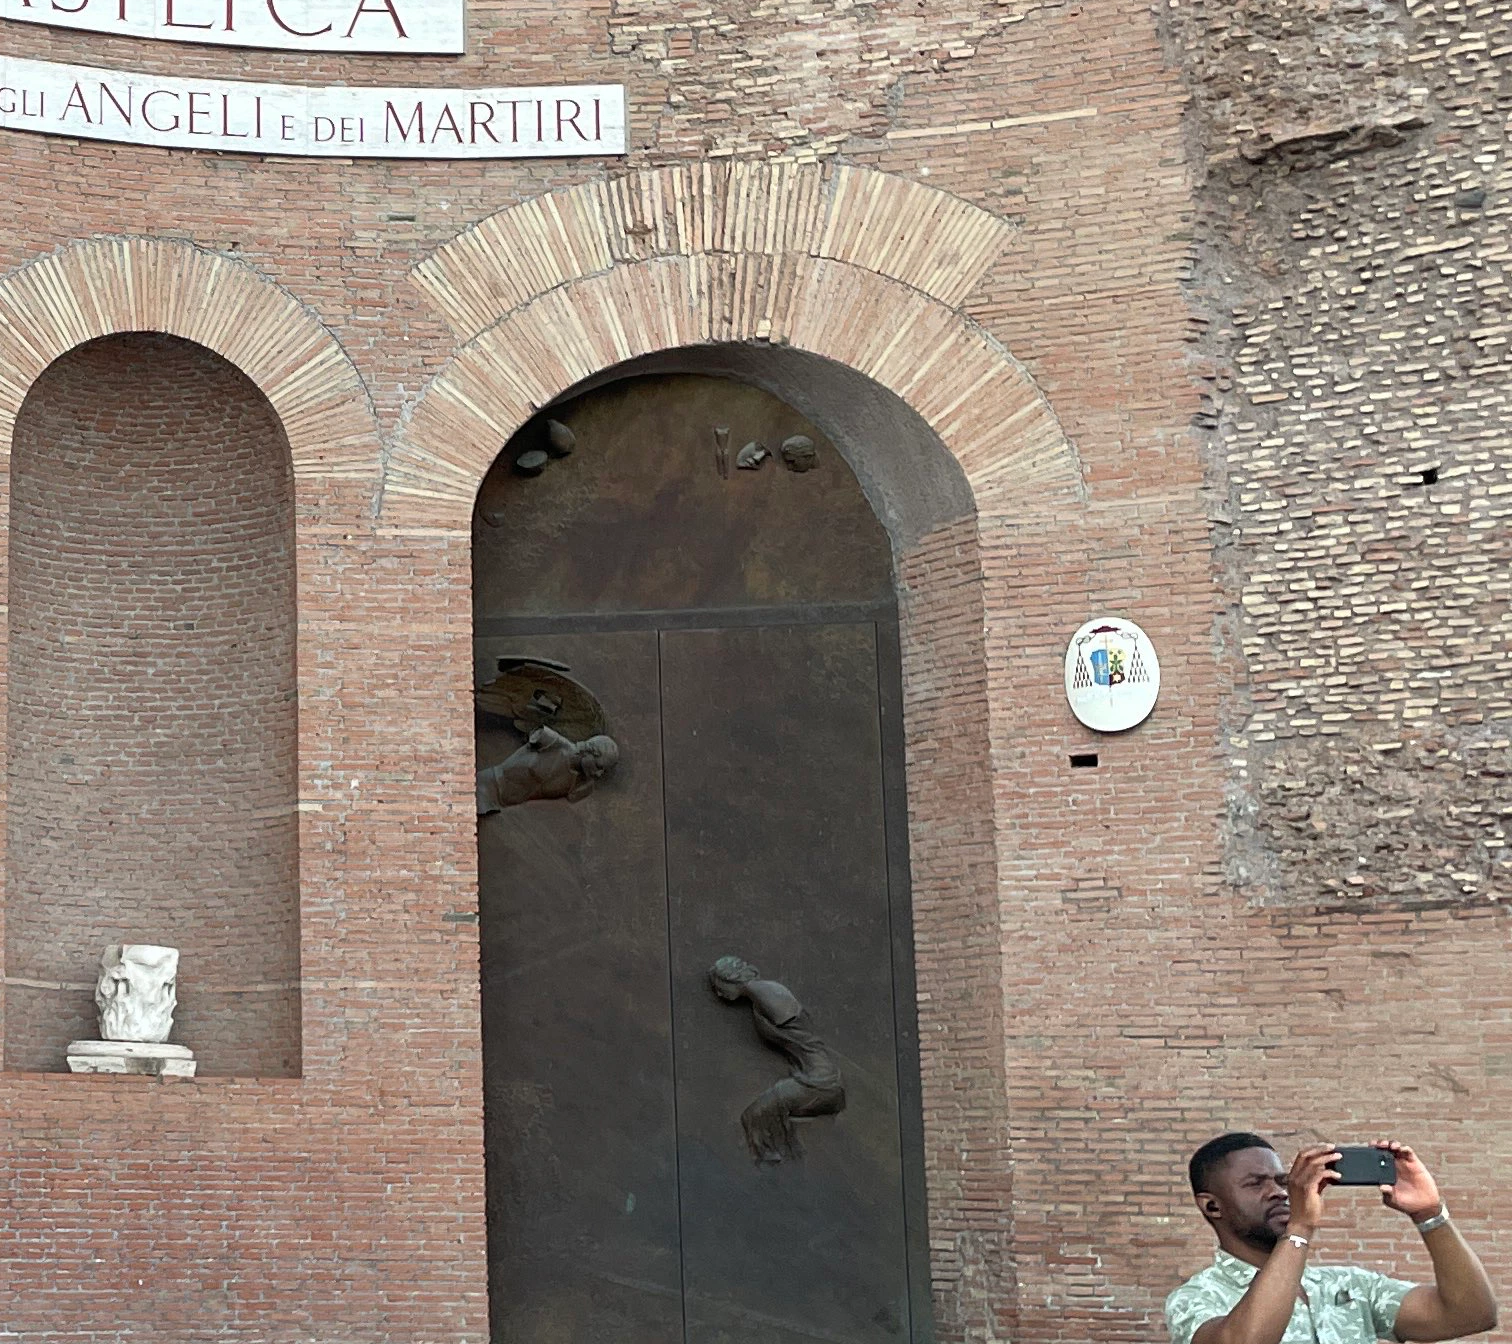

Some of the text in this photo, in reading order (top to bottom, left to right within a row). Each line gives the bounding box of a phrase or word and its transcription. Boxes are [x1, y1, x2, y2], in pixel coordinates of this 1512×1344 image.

[58, 80, 264, 140] ANGELI
[280, 114, 296, 141] E
[313, 116, 365, 143] DEI
[383, 97, 603, 145] MARTIRI
